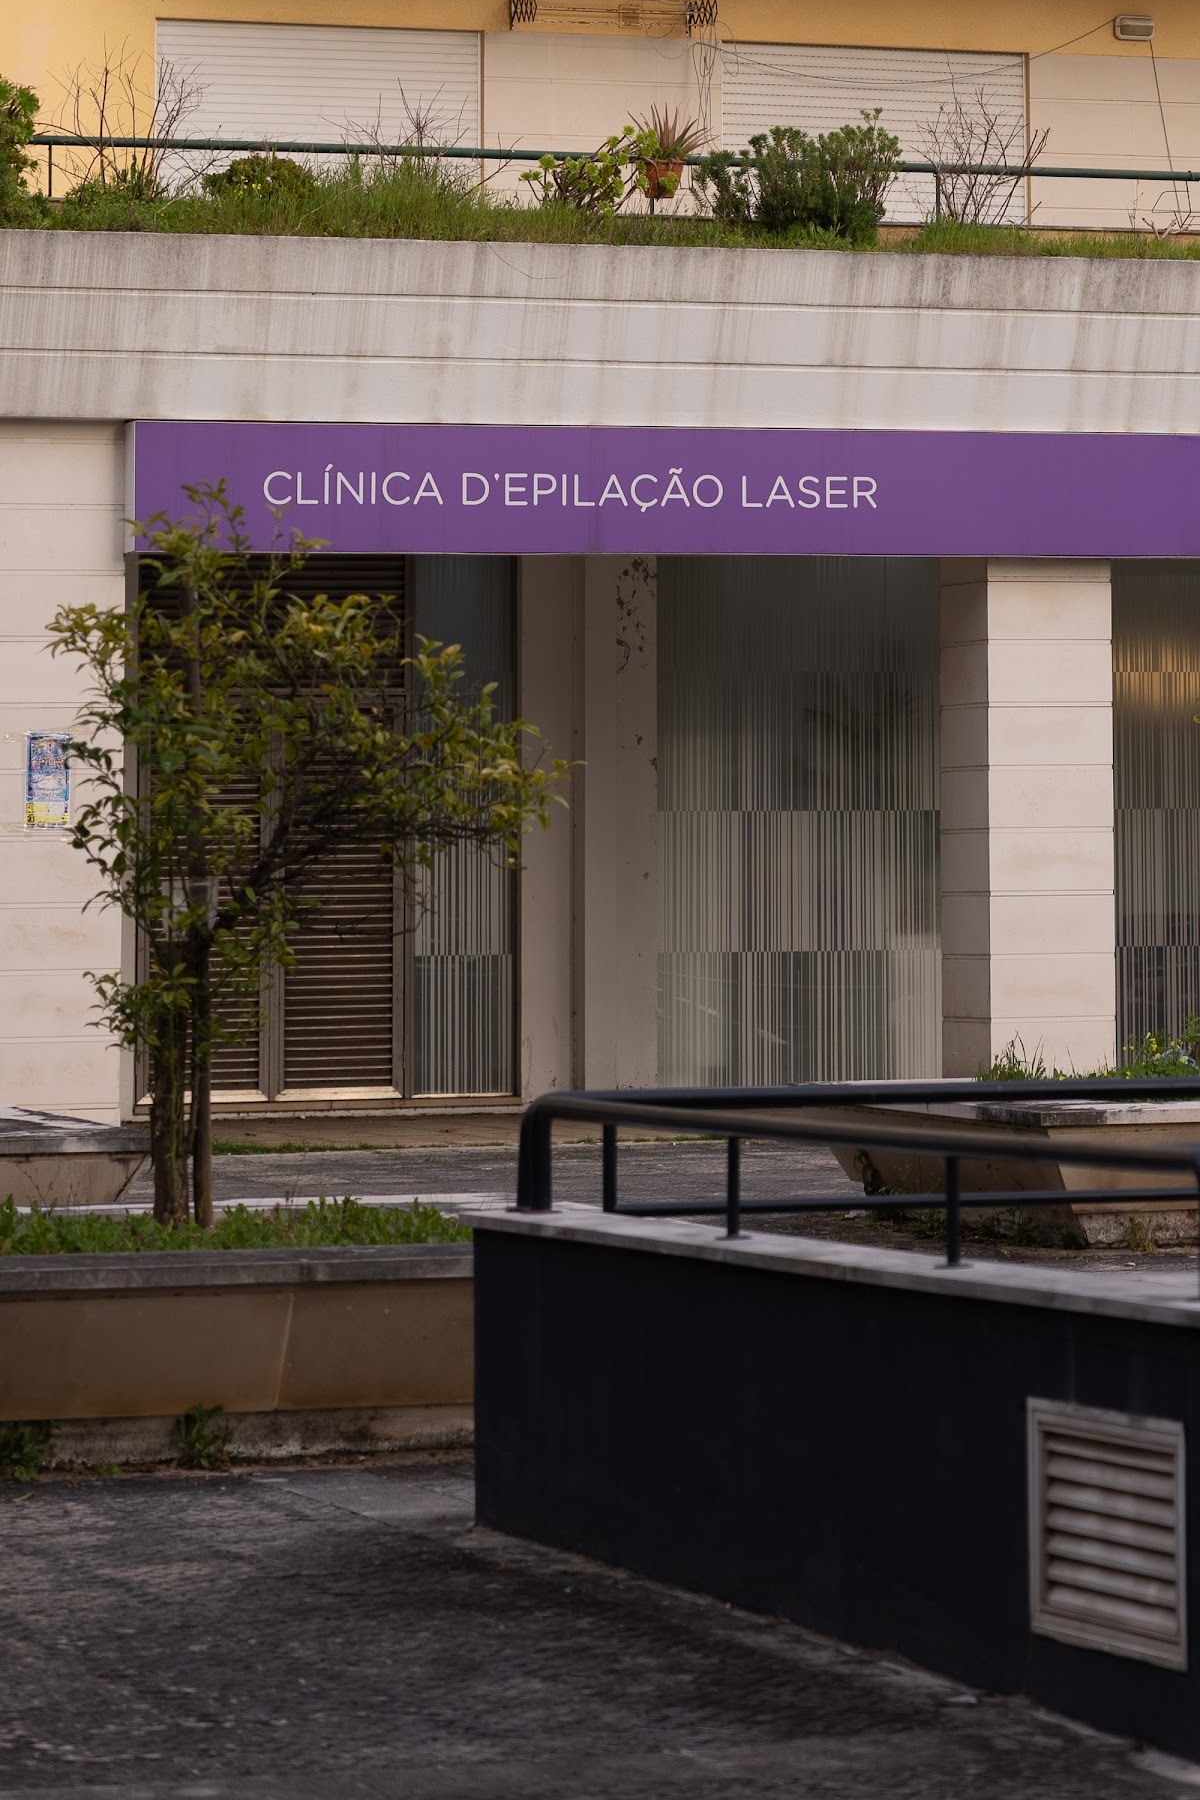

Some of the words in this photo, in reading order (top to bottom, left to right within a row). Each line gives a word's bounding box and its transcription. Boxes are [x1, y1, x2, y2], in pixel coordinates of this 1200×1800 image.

[263, 463, 444, 506] CLÍNICA
[462, 466, 724, 513] D'EPILAÇÃO
[741, 474, 878, 509] LASER
